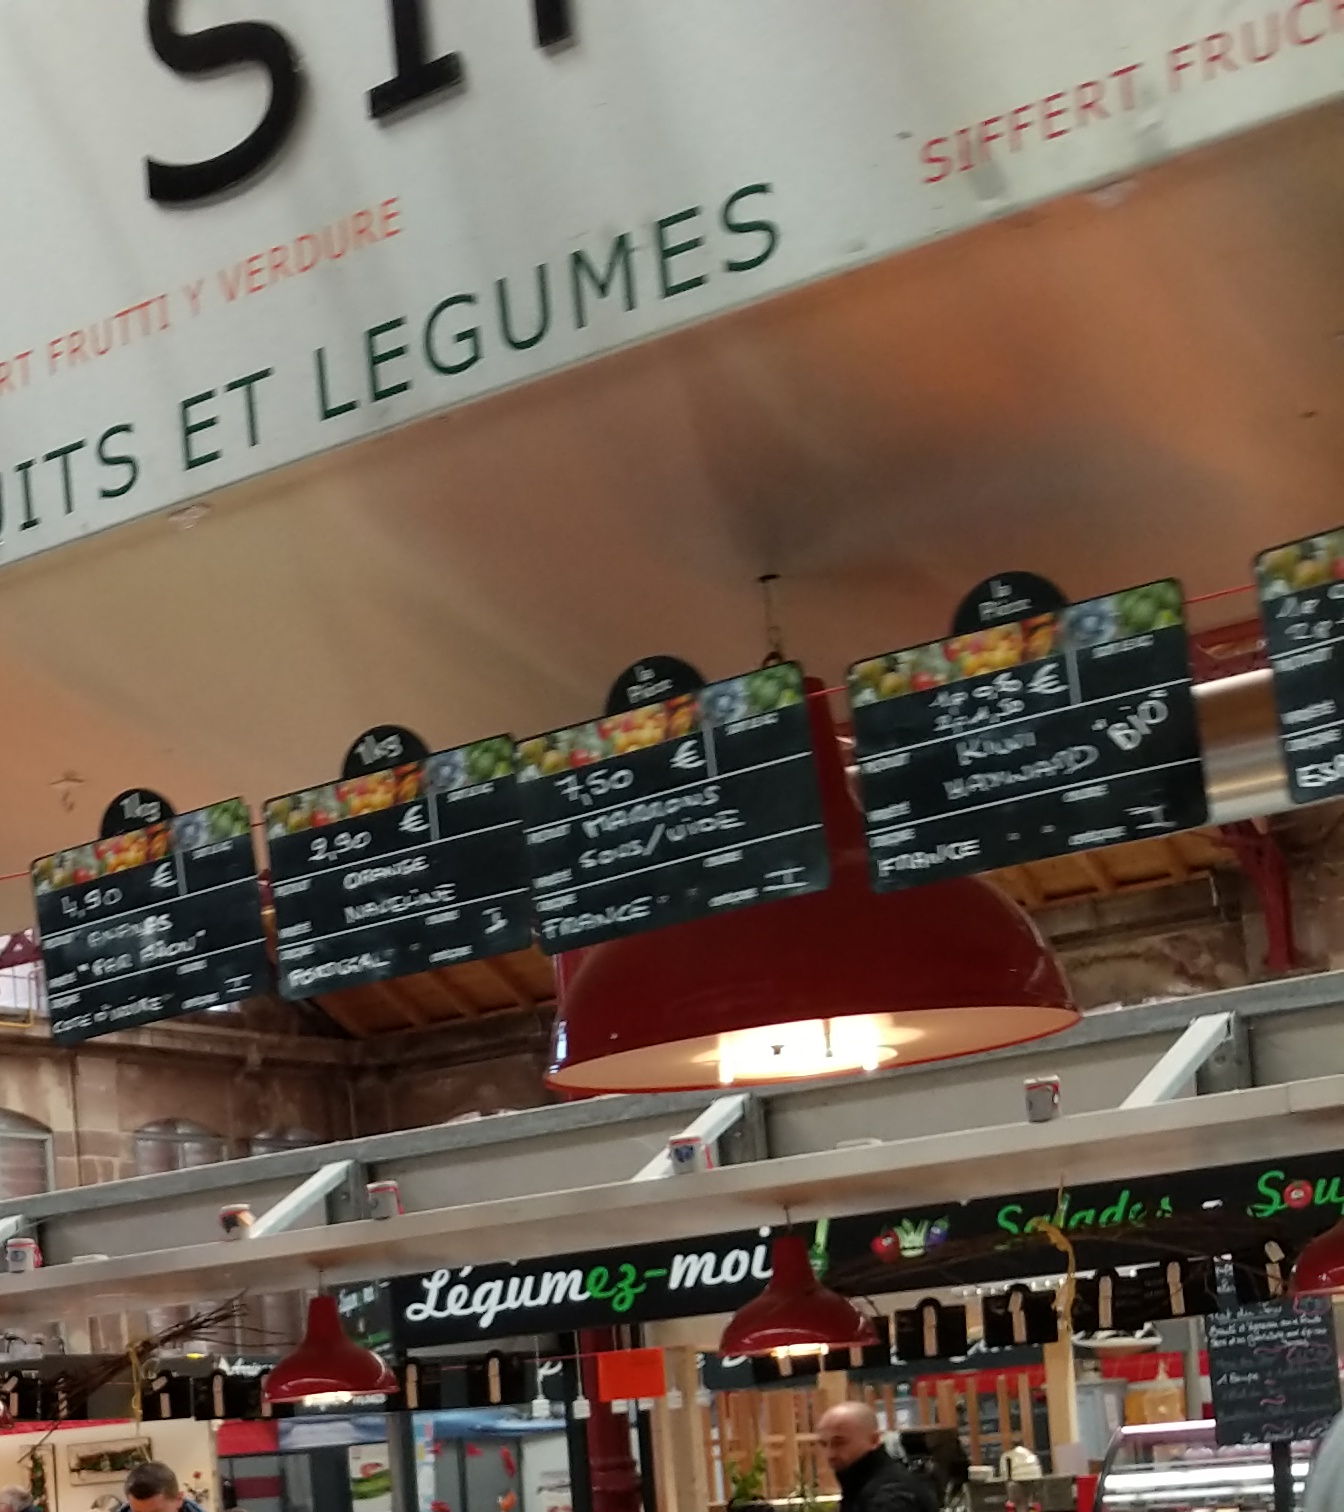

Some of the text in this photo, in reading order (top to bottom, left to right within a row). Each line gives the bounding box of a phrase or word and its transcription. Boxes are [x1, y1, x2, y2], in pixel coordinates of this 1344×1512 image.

[920, 61, 1144, 184] SIFFERT
[48, 290, 170, 374] FRUTTI
[181, 281, 204, 319] Y
[218, 197, 402, 305] VERDURE
[180, 367, 275, 472] ET
[314, 182, 781, 422] LEGUMES
[1246, 1169, 1344, 1218] Sou
[406, 1225, 776, 1328] Légumez-moi
